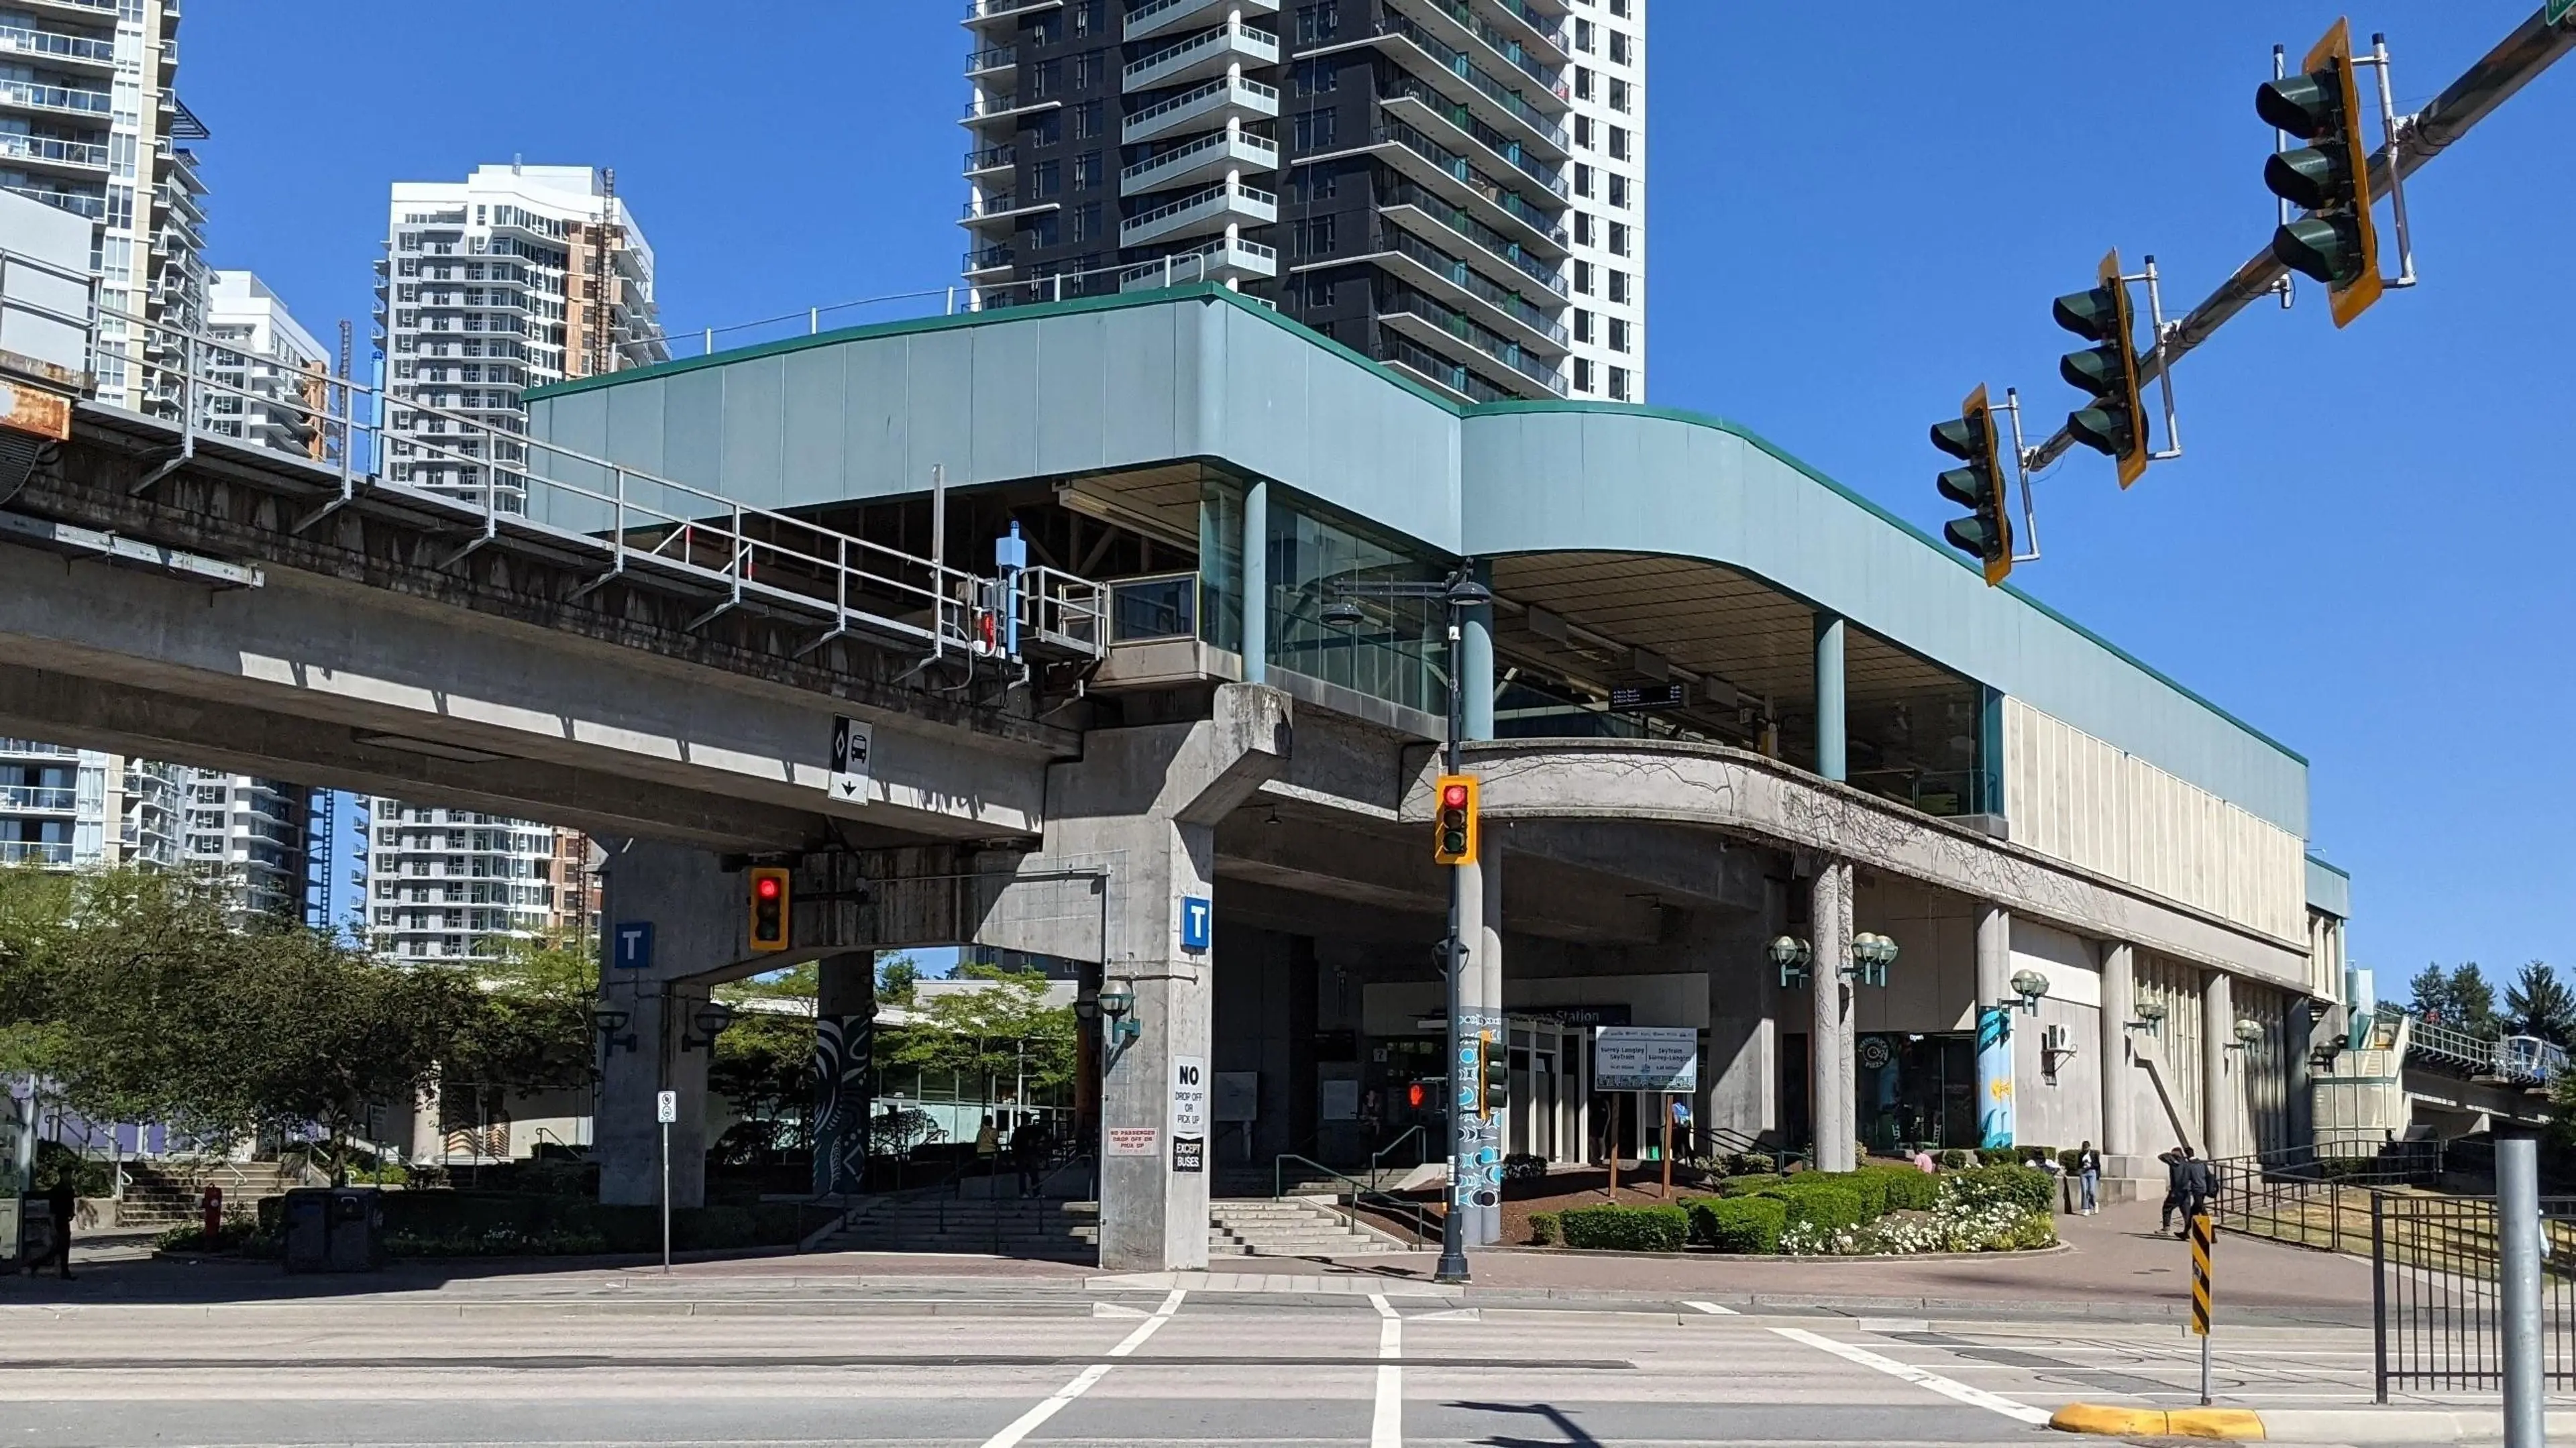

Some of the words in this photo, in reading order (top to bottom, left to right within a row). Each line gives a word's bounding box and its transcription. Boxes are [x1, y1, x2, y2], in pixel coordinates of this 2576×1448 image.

[1191, 905, 1205, 938] T
[623, 931, 642, 960] T
[1556, 1009, 1599, 1023] Station
[1179, 1065, 1199, 1085] NO
[1175, 1092, 1190, 1101] DROP
[1191, 1093, 1203, 1102] OFF
[1185, 1104, 1193, 1113] OR
[1177, 1115, 1190, 1123] PICK
[1192, 1115, 1200, 1124] UP
[1176, 1143, 1201, 1154] EXCEPT
